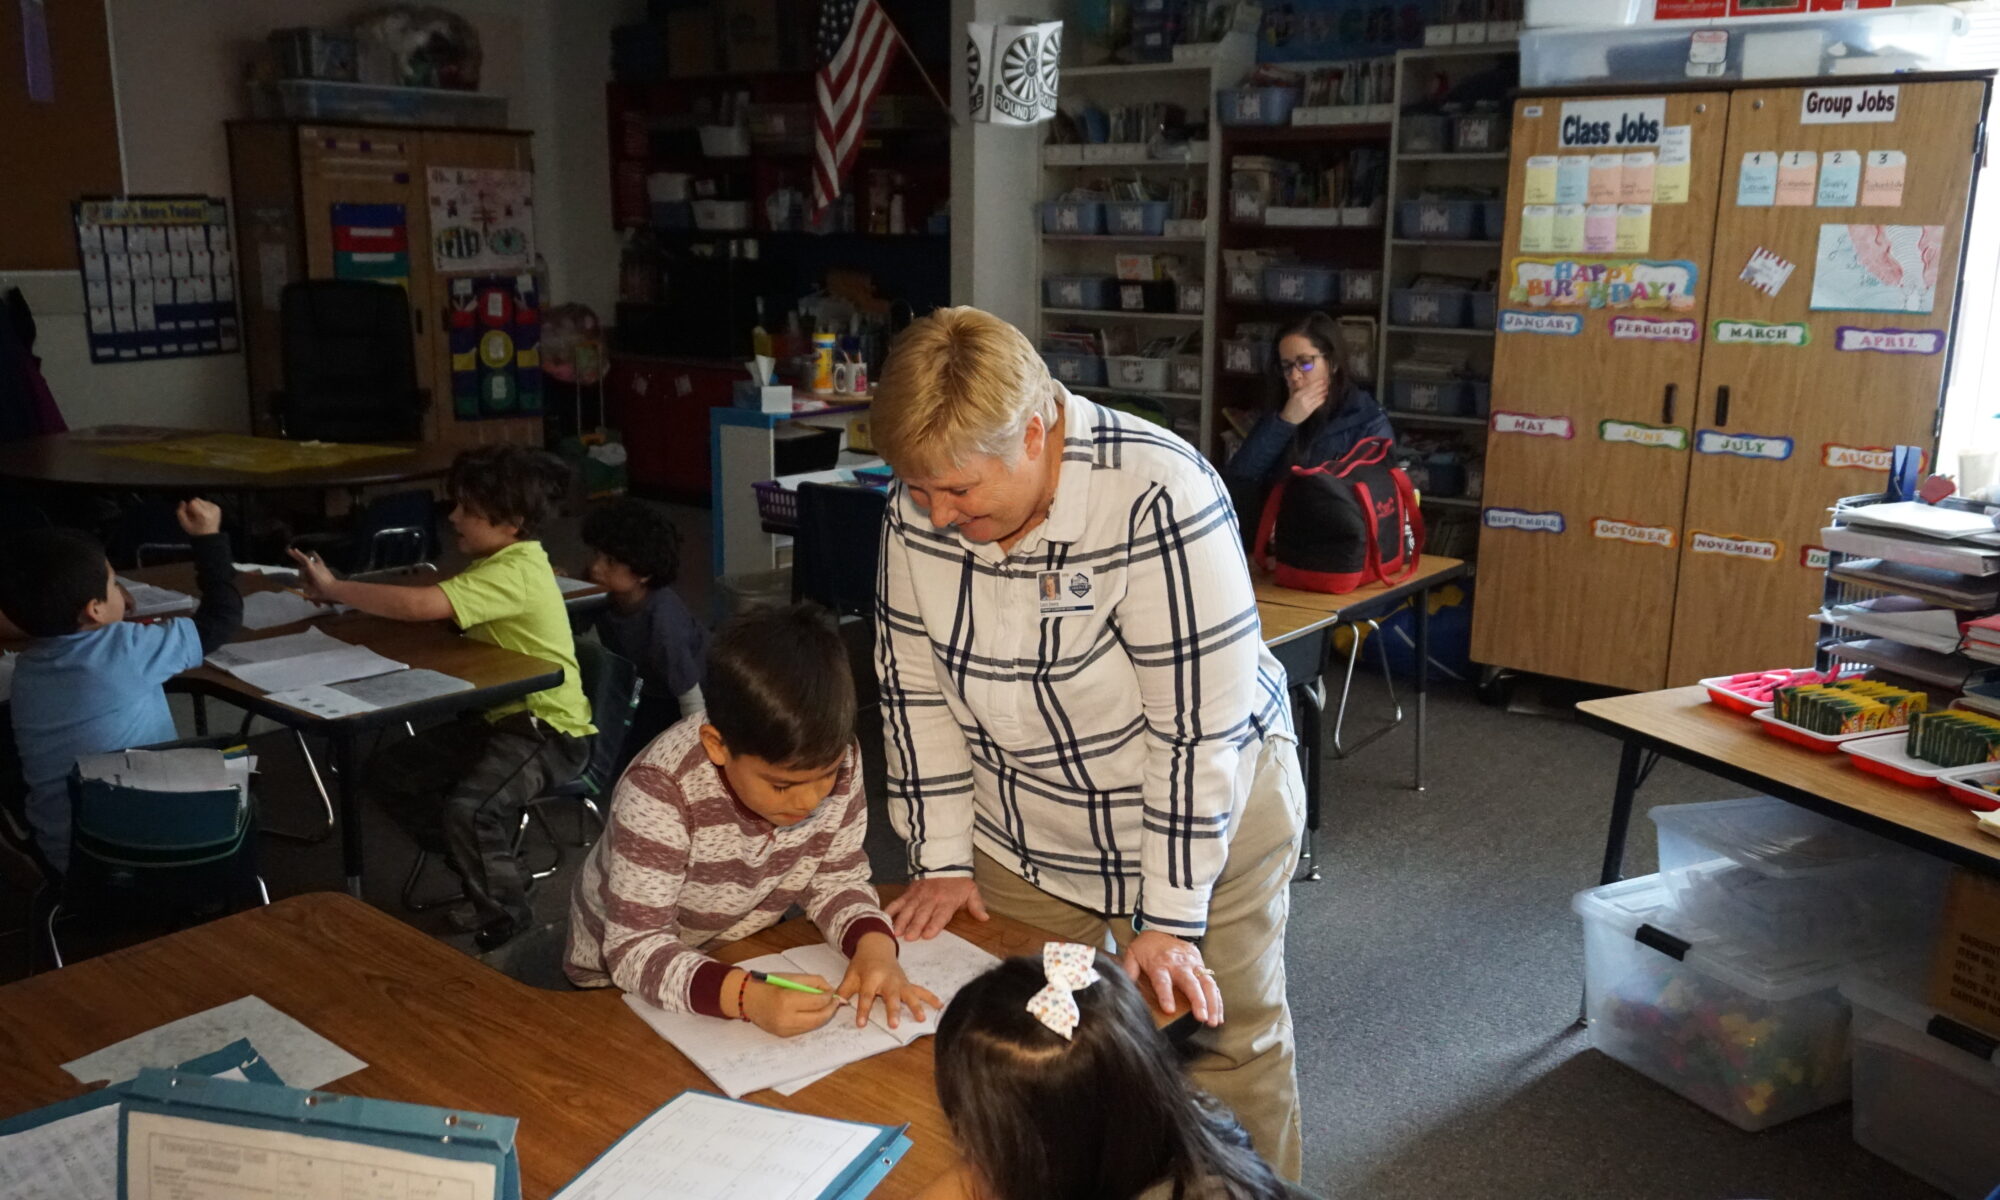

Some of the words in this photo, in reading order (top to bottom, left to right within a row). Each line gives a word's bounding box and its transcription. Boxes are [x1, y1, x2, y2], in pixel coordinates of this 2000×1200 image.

[995, 95, 1029, 120] ROUND
[1806, 90, 1853, 118] Group
[1856, 88, 1895, 112] Jobs
[1563, 114, 1610, 146] Class
[1615, 112, 1660, 144] Jobs
[1792, 153, 1799, 165] 1
[1833, 152, 1842, 164] 2
[1879, 152, 1888, 164] 3
[1554, 261, 1640, 284] HAPPY
[1527, 278, 1677, 304] BIRTHDAY!
[1505, 315, 1575, 331] JANUARY
[1614, 321, 1693, 338] FEBRUARY
[1730, 327, 1788, 340] MARCH
[1859, 335, 1919, 348] APRIL
[1513, 417, 1546, 432] MAY
[1623, 428, 1665, 442] JUNE
[1720, 439, 1767, 453] JULY
[1836, 450, 1893, 467] AUGUS
[1490, 515, 1558, 529] SEPTEMBER
[1600, 523, 1668, 543] OCTOBER
[1695, 537, 1773, 557] NOVEMBER
